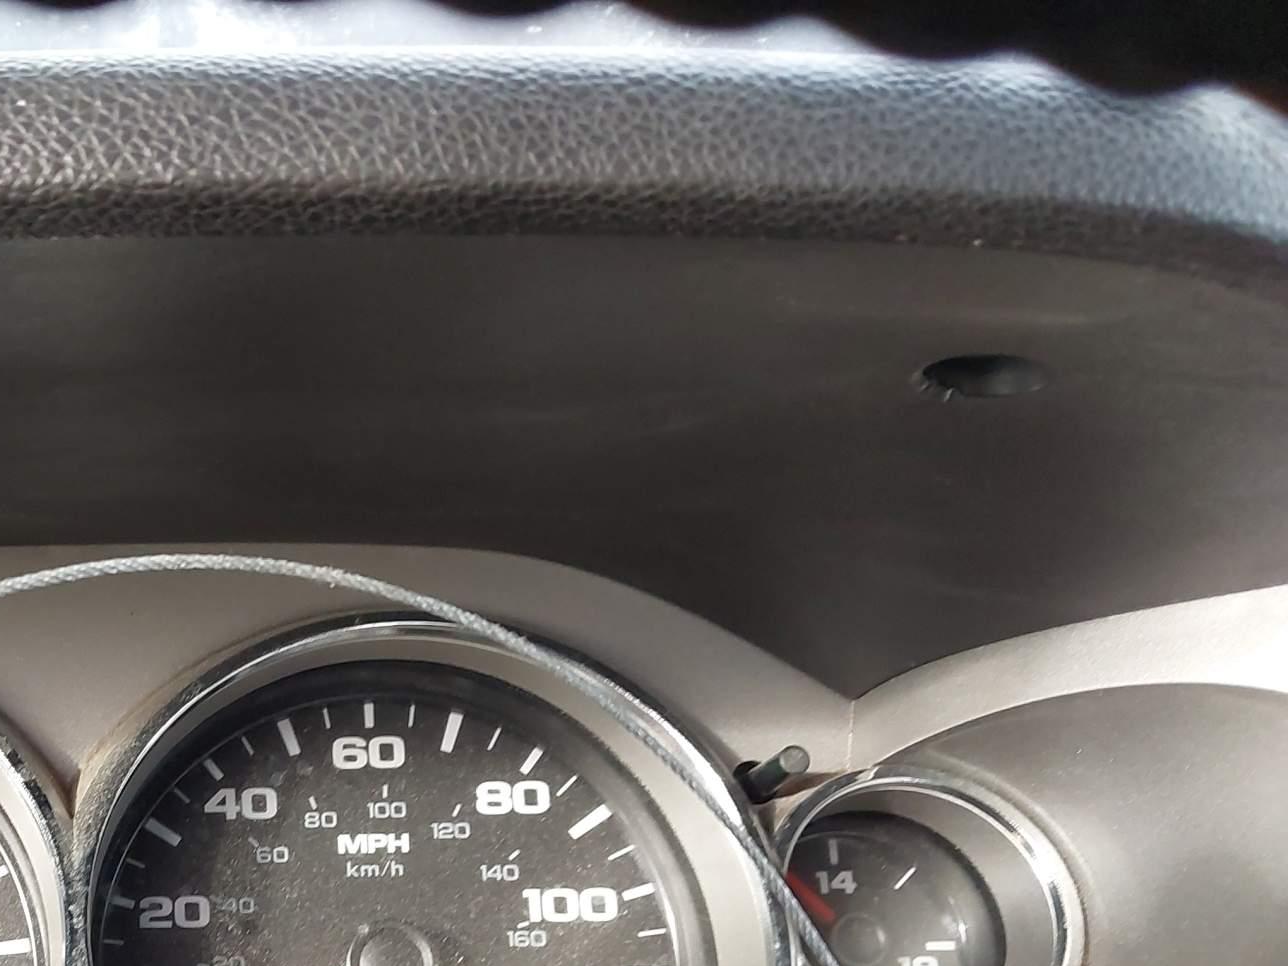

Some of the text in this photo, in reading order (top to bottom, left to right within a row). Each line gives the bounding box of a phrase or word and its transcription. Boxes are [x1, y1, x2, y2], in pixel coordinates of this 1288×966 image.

[332, 735, 405, 770] 60
[204, 787, 278, 820] 40
[476, 780, 550, 815] 80
[304, 811, 337, 828] 80
[367, 802, 407, 819] 100
[430, 822, 471, 839] 120
[337, 832, 410, 855] MPH
[256, 846, 289, 863] 60
[346, 860, 404, 878] km/h
[480, 864, 519, 881] 140
[815, 870, 857, 895] 14
[139, 895, 210, 929] 20
[217, 897, 254, 914] 40
[522, 887, 618, 923] 100
[507, 930, 546, 947] 160
